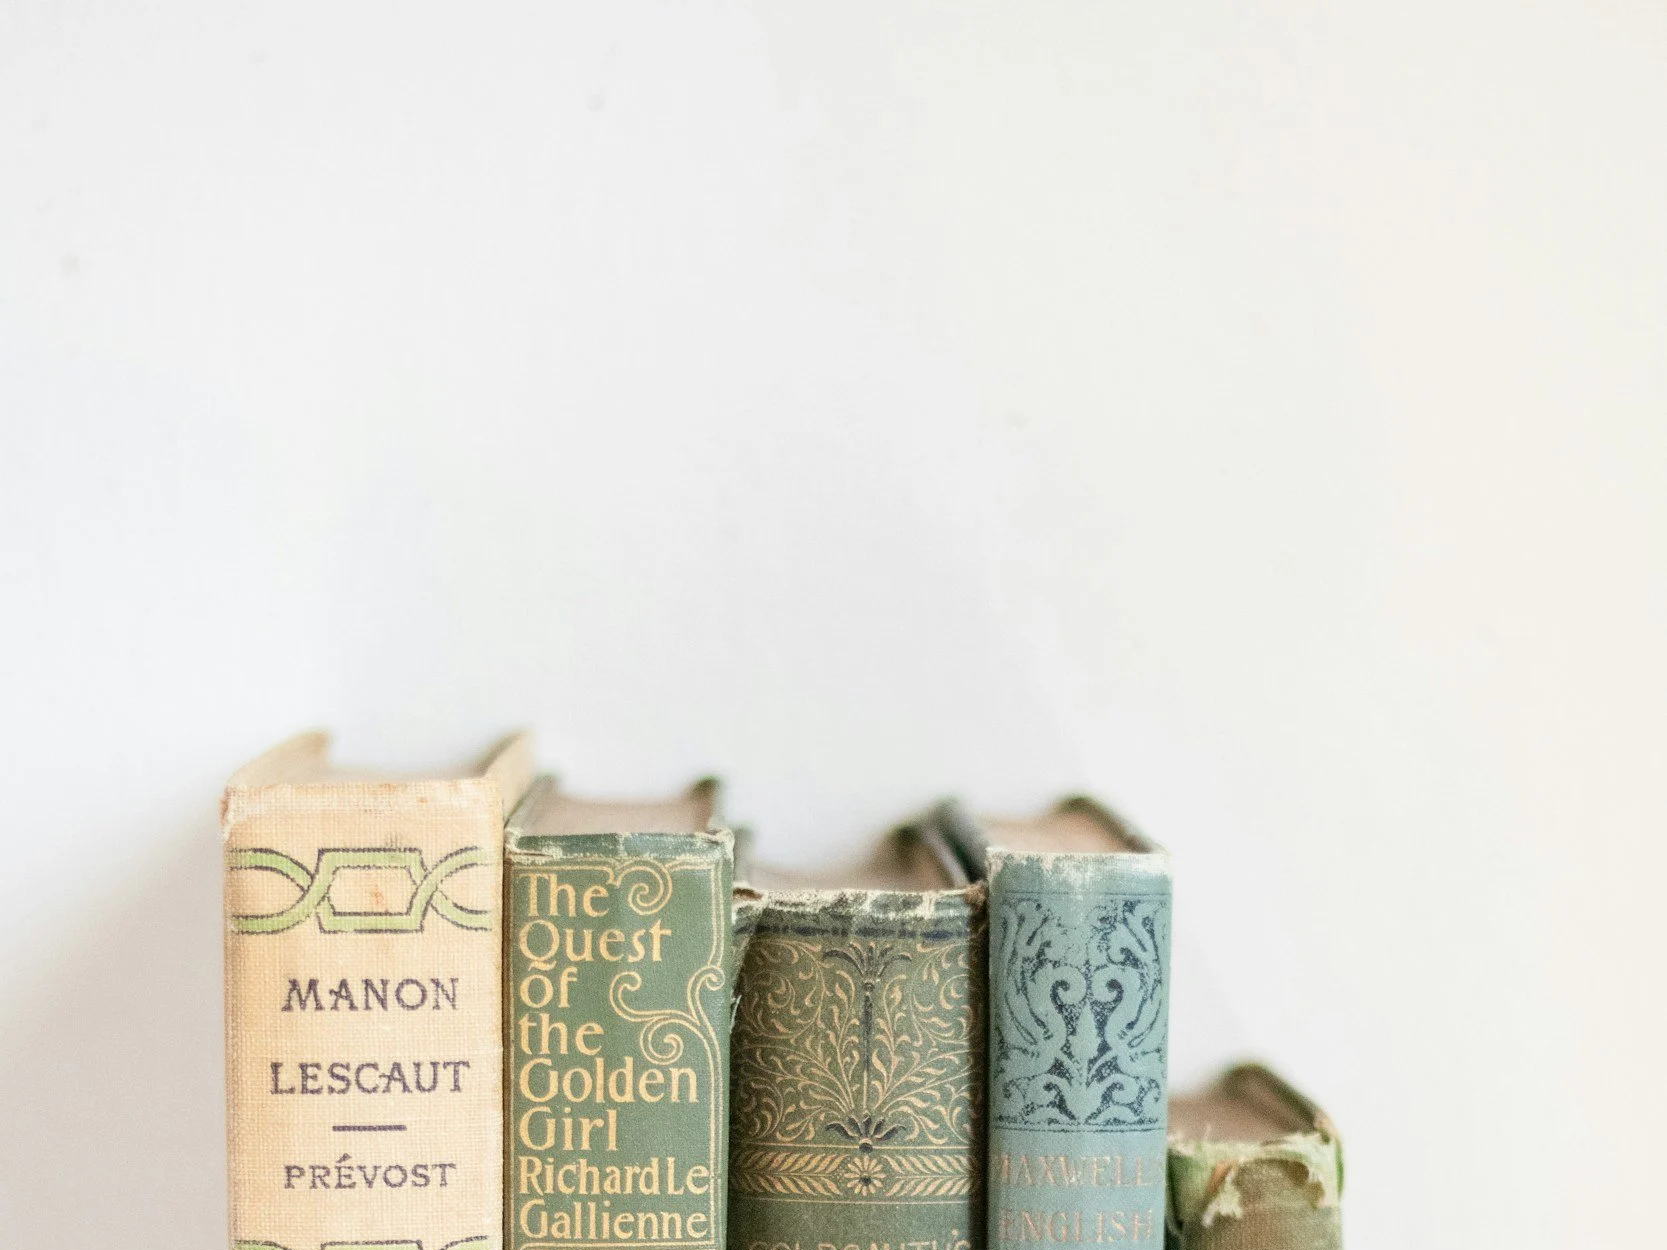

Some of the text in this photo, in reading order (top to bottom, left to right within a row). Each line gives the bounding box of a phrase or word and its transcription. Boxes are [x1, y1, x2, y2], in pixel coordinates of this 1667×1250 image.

[519, 873, 609, 917] The
[518, 919, 672, 971] Quest
[281, 977, 460, 1012] MANON
[518, 1012, 605, 1056] the
[270, 1061, 470, 1095] LESCAUT
[519, 1057, 699, 1103] Golden
[519, 1106, 618, 1151] Girl
[284, 1153, 456, 1189] PRÉVOST
[519, 1155, 710, 1196] Richard Le
[519, 1198, 709, 1240] Gallienne
[998, 1209, 1154, 1243] ENGLISH
